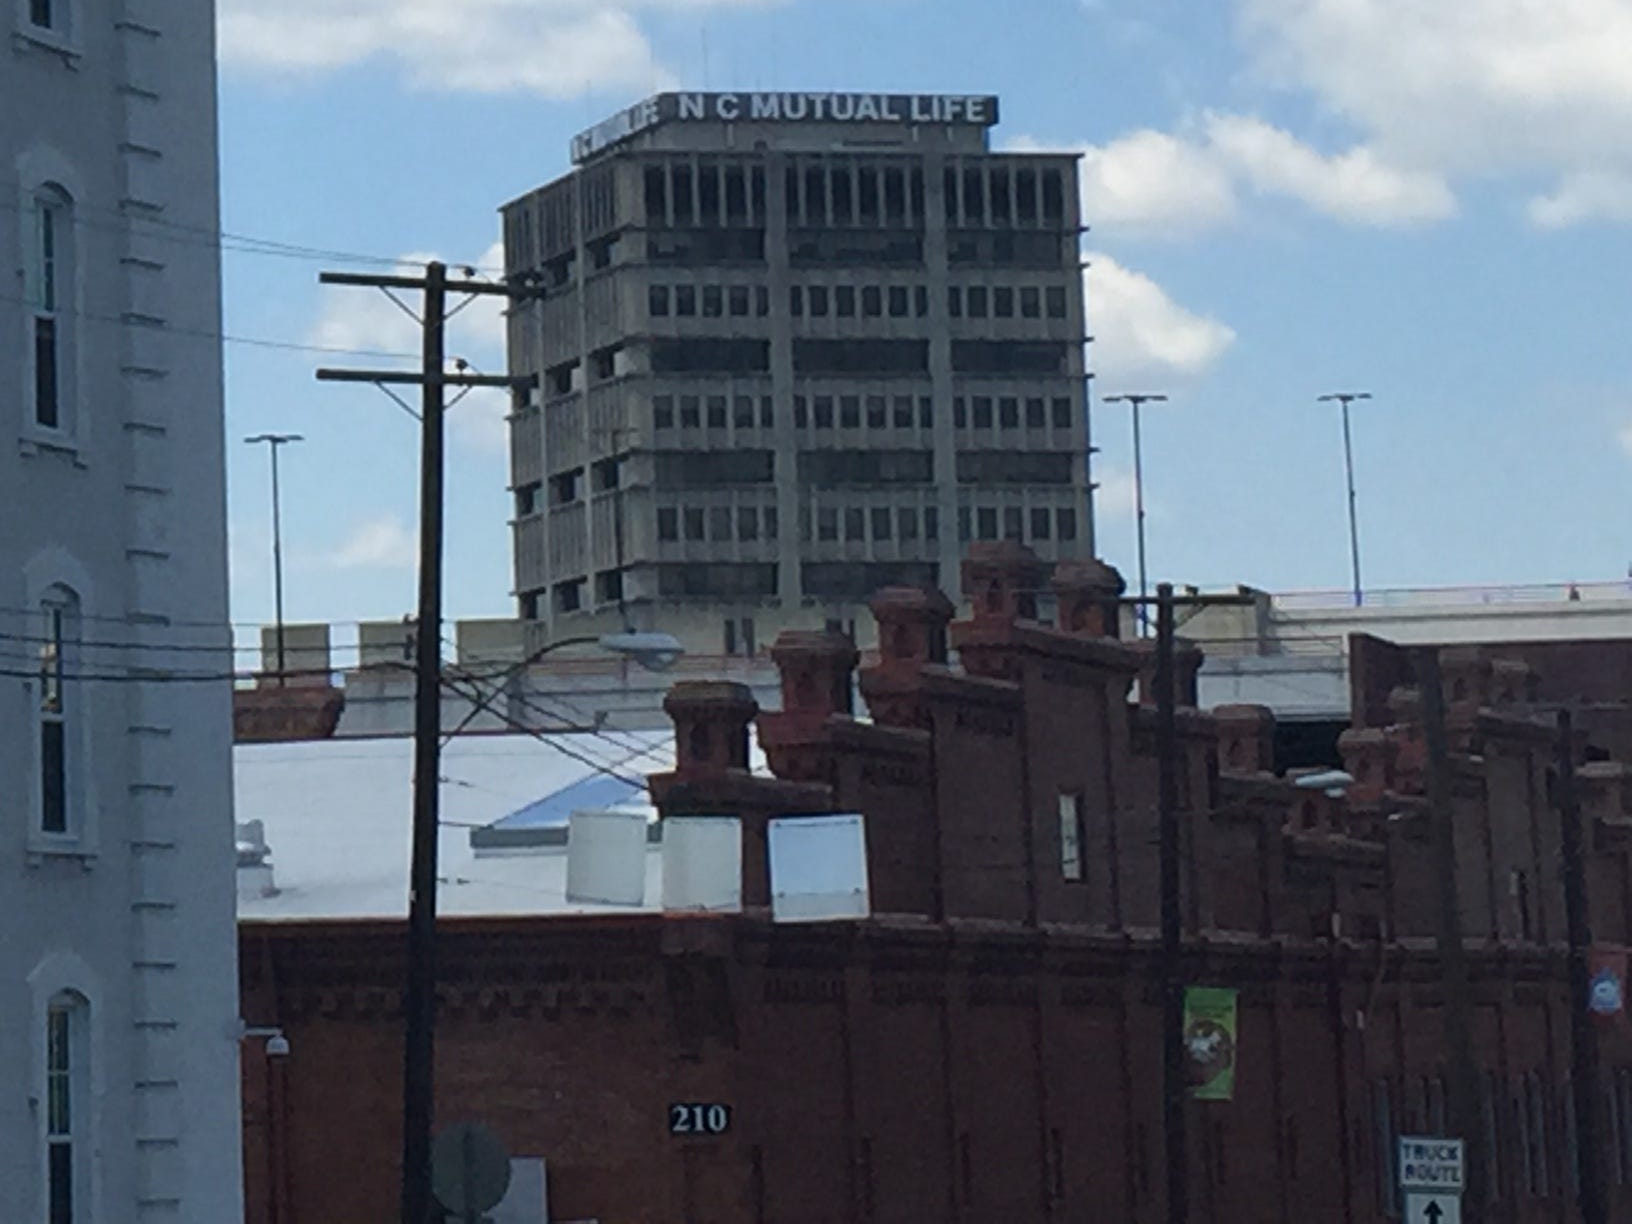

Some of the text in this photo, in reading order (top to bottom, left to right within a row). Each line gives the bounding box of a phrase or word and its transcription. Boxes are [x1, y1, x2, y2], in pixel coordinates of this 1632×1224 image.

[750, 93, 900, 121] MUTUAL
[910, 95, 986, 122] LIFE
[671, 1104, 728, 1132] 210
[1402, 1143, 1459, 1161] TRUCK
[1405, 1163, 1461, 1183] ROUTE
